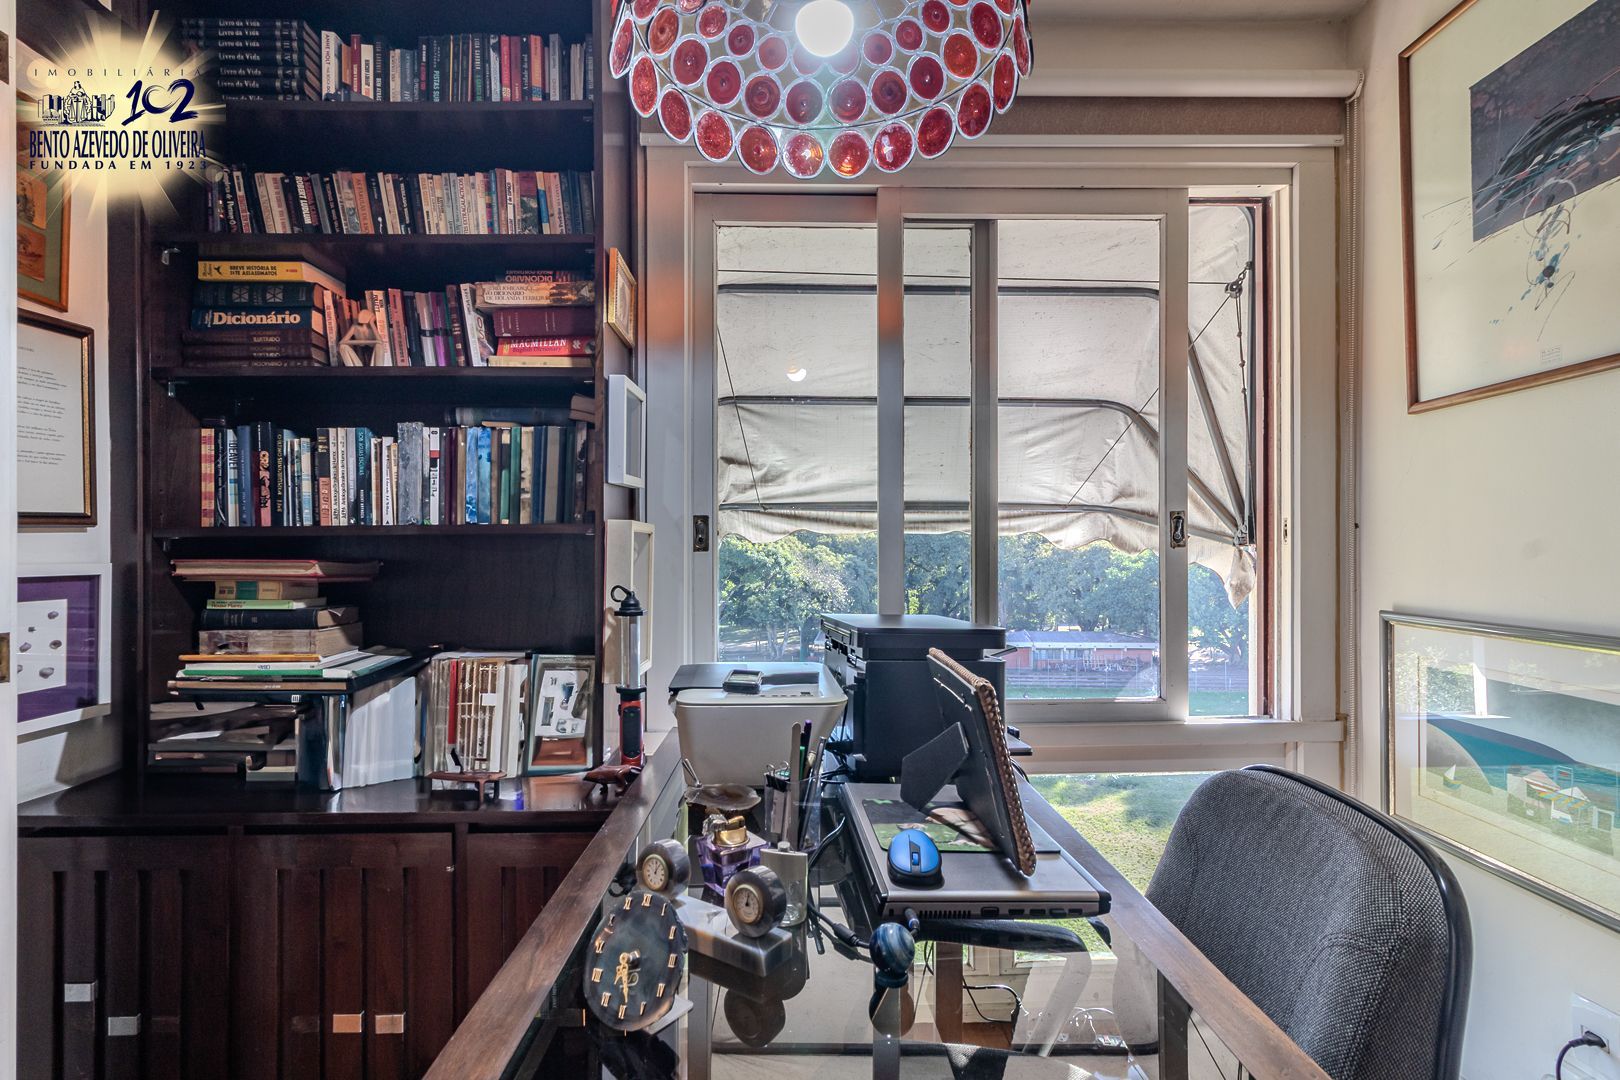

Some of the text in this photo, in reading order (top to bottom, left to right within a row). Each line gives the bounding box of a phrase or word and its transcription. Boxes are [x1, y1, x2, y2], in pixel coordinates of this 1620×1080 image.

[218, 80, 235, 88] Livro
[244, 80, 260, 88] Vida
[295, 176, 312, 224] ROBERT LUDLUM
[213, 310, 300, 325] Dicionário
[511, 340, 566, 348] MACMILLAN
